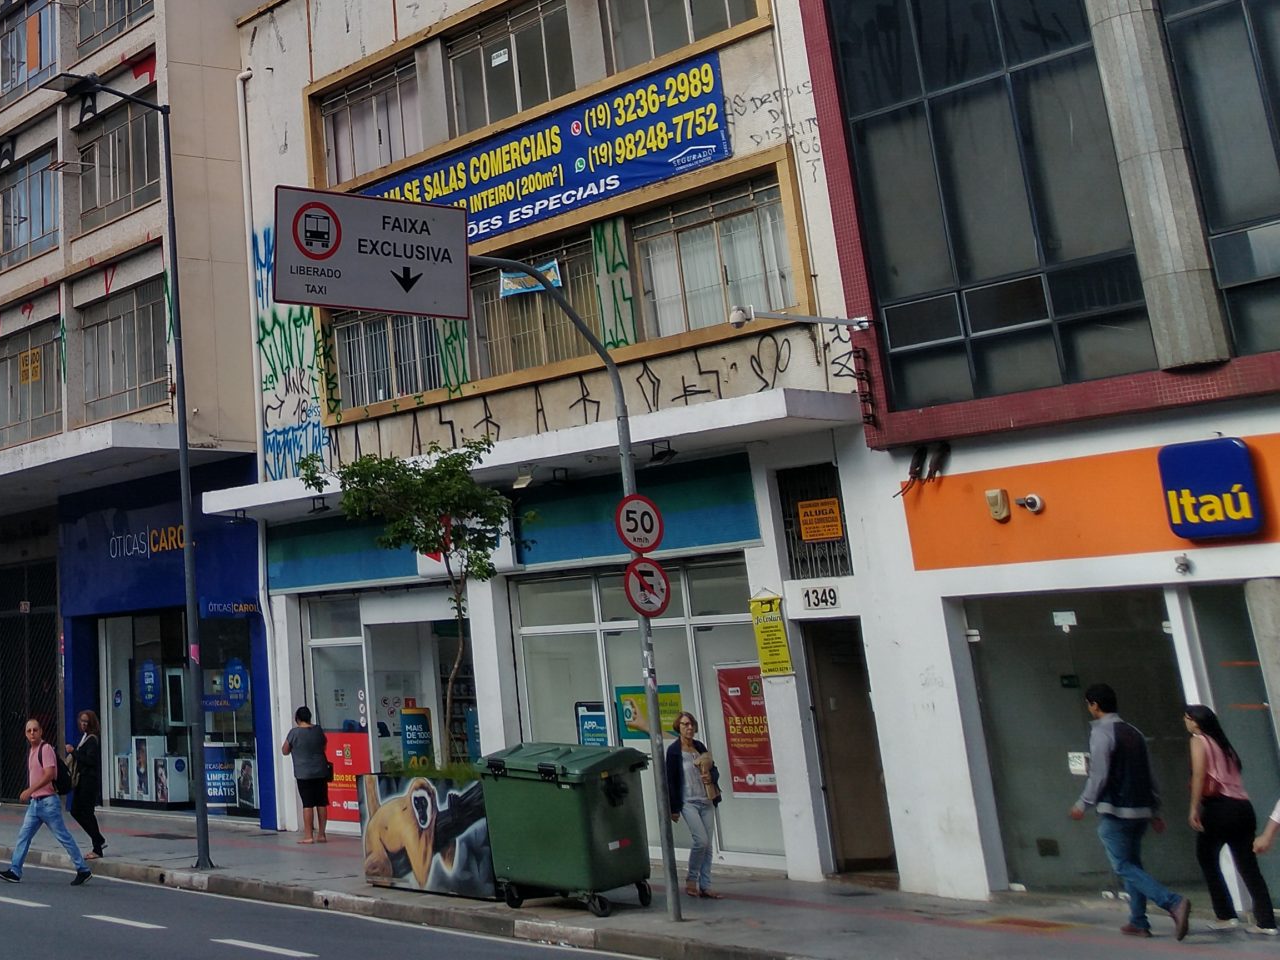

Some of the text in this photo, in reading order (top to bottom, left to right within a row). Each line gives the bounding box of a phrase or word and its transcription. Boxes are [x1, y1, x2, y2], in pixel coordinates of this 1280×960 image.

[584, 63, 715, 136] (19) 3236-2989
[588, 143, 613, 172] (19)
[615, 102, 719, 165] 98248-7752
[424, 162, 467, 203] SALAS
[470, 125, 563, 184] COMERCIAIS
[470, 182, 515, 214] INTEIRO
[508, 174, 621, 225] ESPECIAIS
[381, 215, 431, 236] FAIXA
[357, 238, 453, 264] EXCLUSIVA
[289, 264, 342, 279] LIBERADO
[304, 283, 328, 296] TAXI
[803, 507, 835, 518] ALUGA
[1167, 483, 1253, 525] Itaú
[625, 509, 655, 534] 50
[109, 524, 196, 559] ÓTICAS CARO
[632, 535, 650, 544] km/h
[804, 587, 837, 608] 1349
[208, 601, 257, 613] ÓTICAS CAROL
[405, 724, 423, 732] MAIS
[583, 720, 597, 730] APP
[729, 725, 769, 737] DE GRAÇA
[406, 731, 417, 739] DE
[206, 772, 234, 782] LIMPEZA
[207, 786, 235, 797] GRÁTIS
